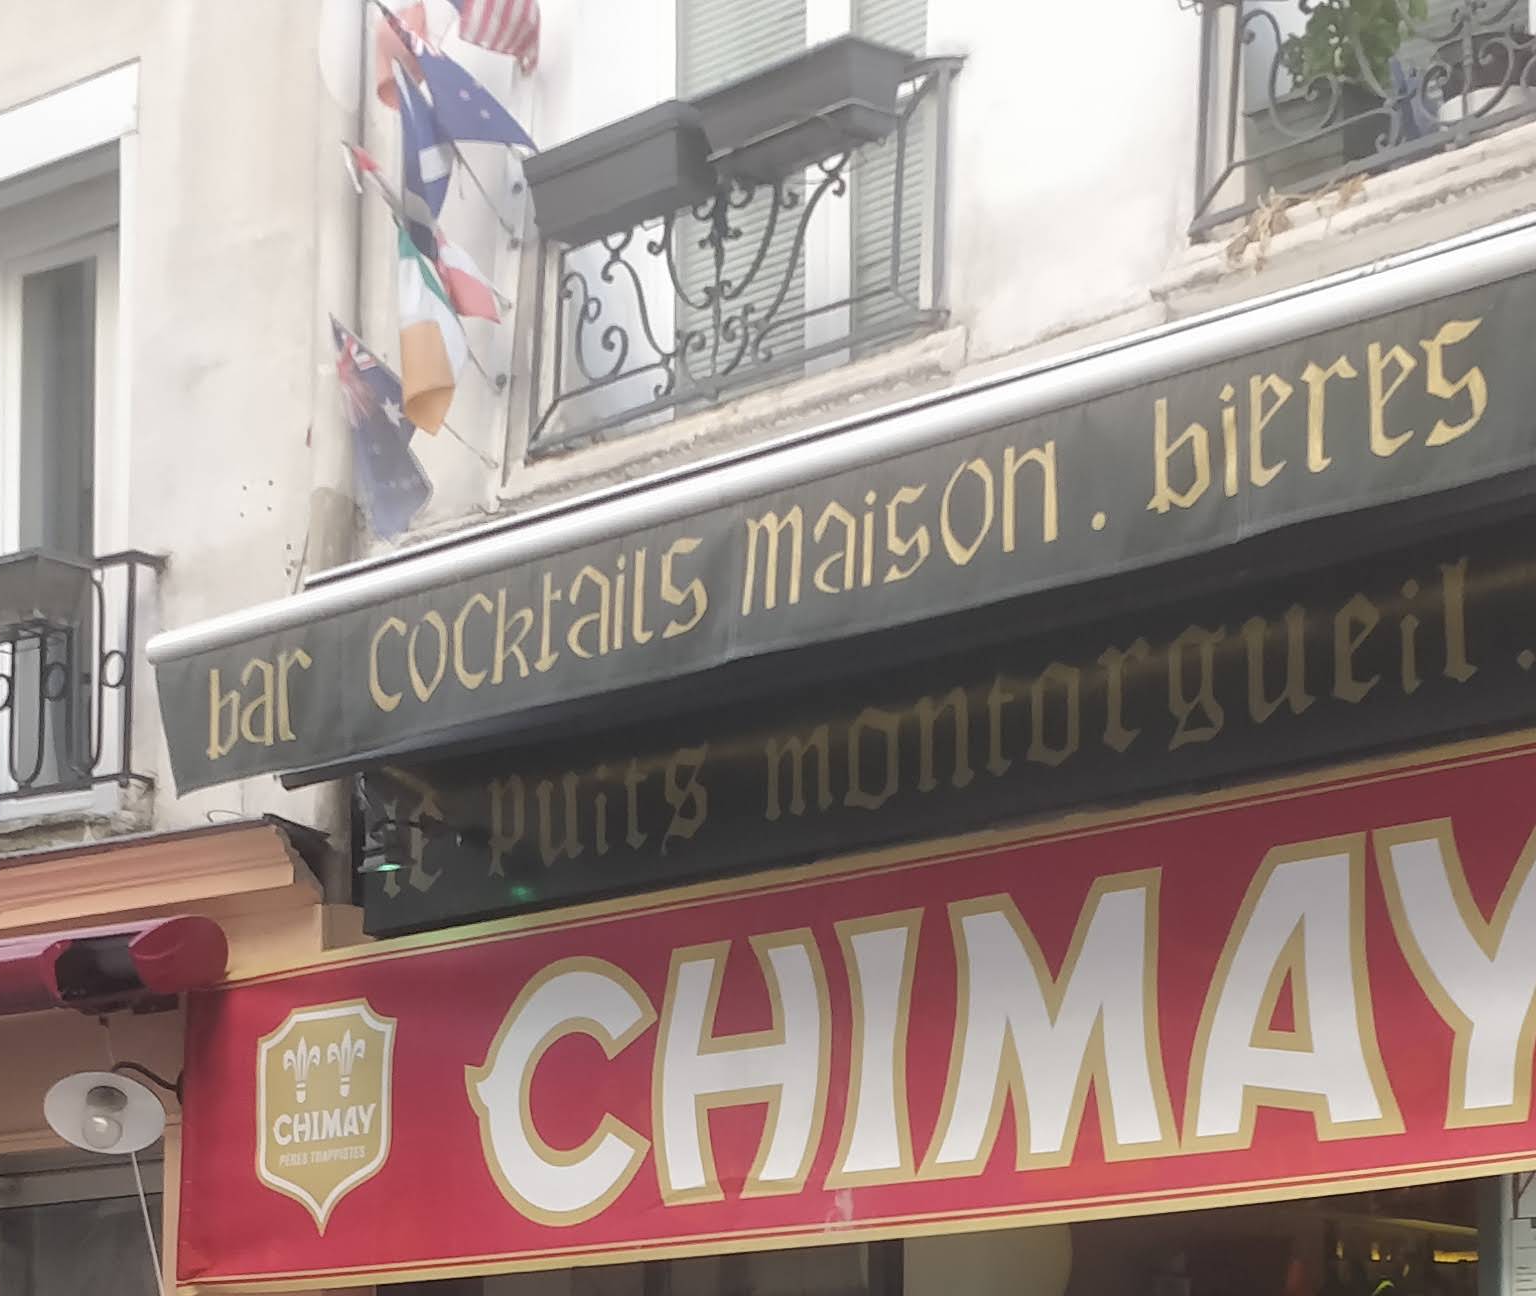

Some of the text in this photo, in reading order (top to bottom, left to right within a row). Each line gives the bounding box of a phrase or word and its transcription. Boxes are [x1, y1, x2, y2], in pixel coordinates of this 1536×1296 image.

[206, 649, 313, 762] bar
[367, 536, 709, 713] cocktails
[487, 742, 709, 878] puits
[765, 555, 1479, 822] montorgueil
[272, 1102, 377, 1146] CHIMAY
